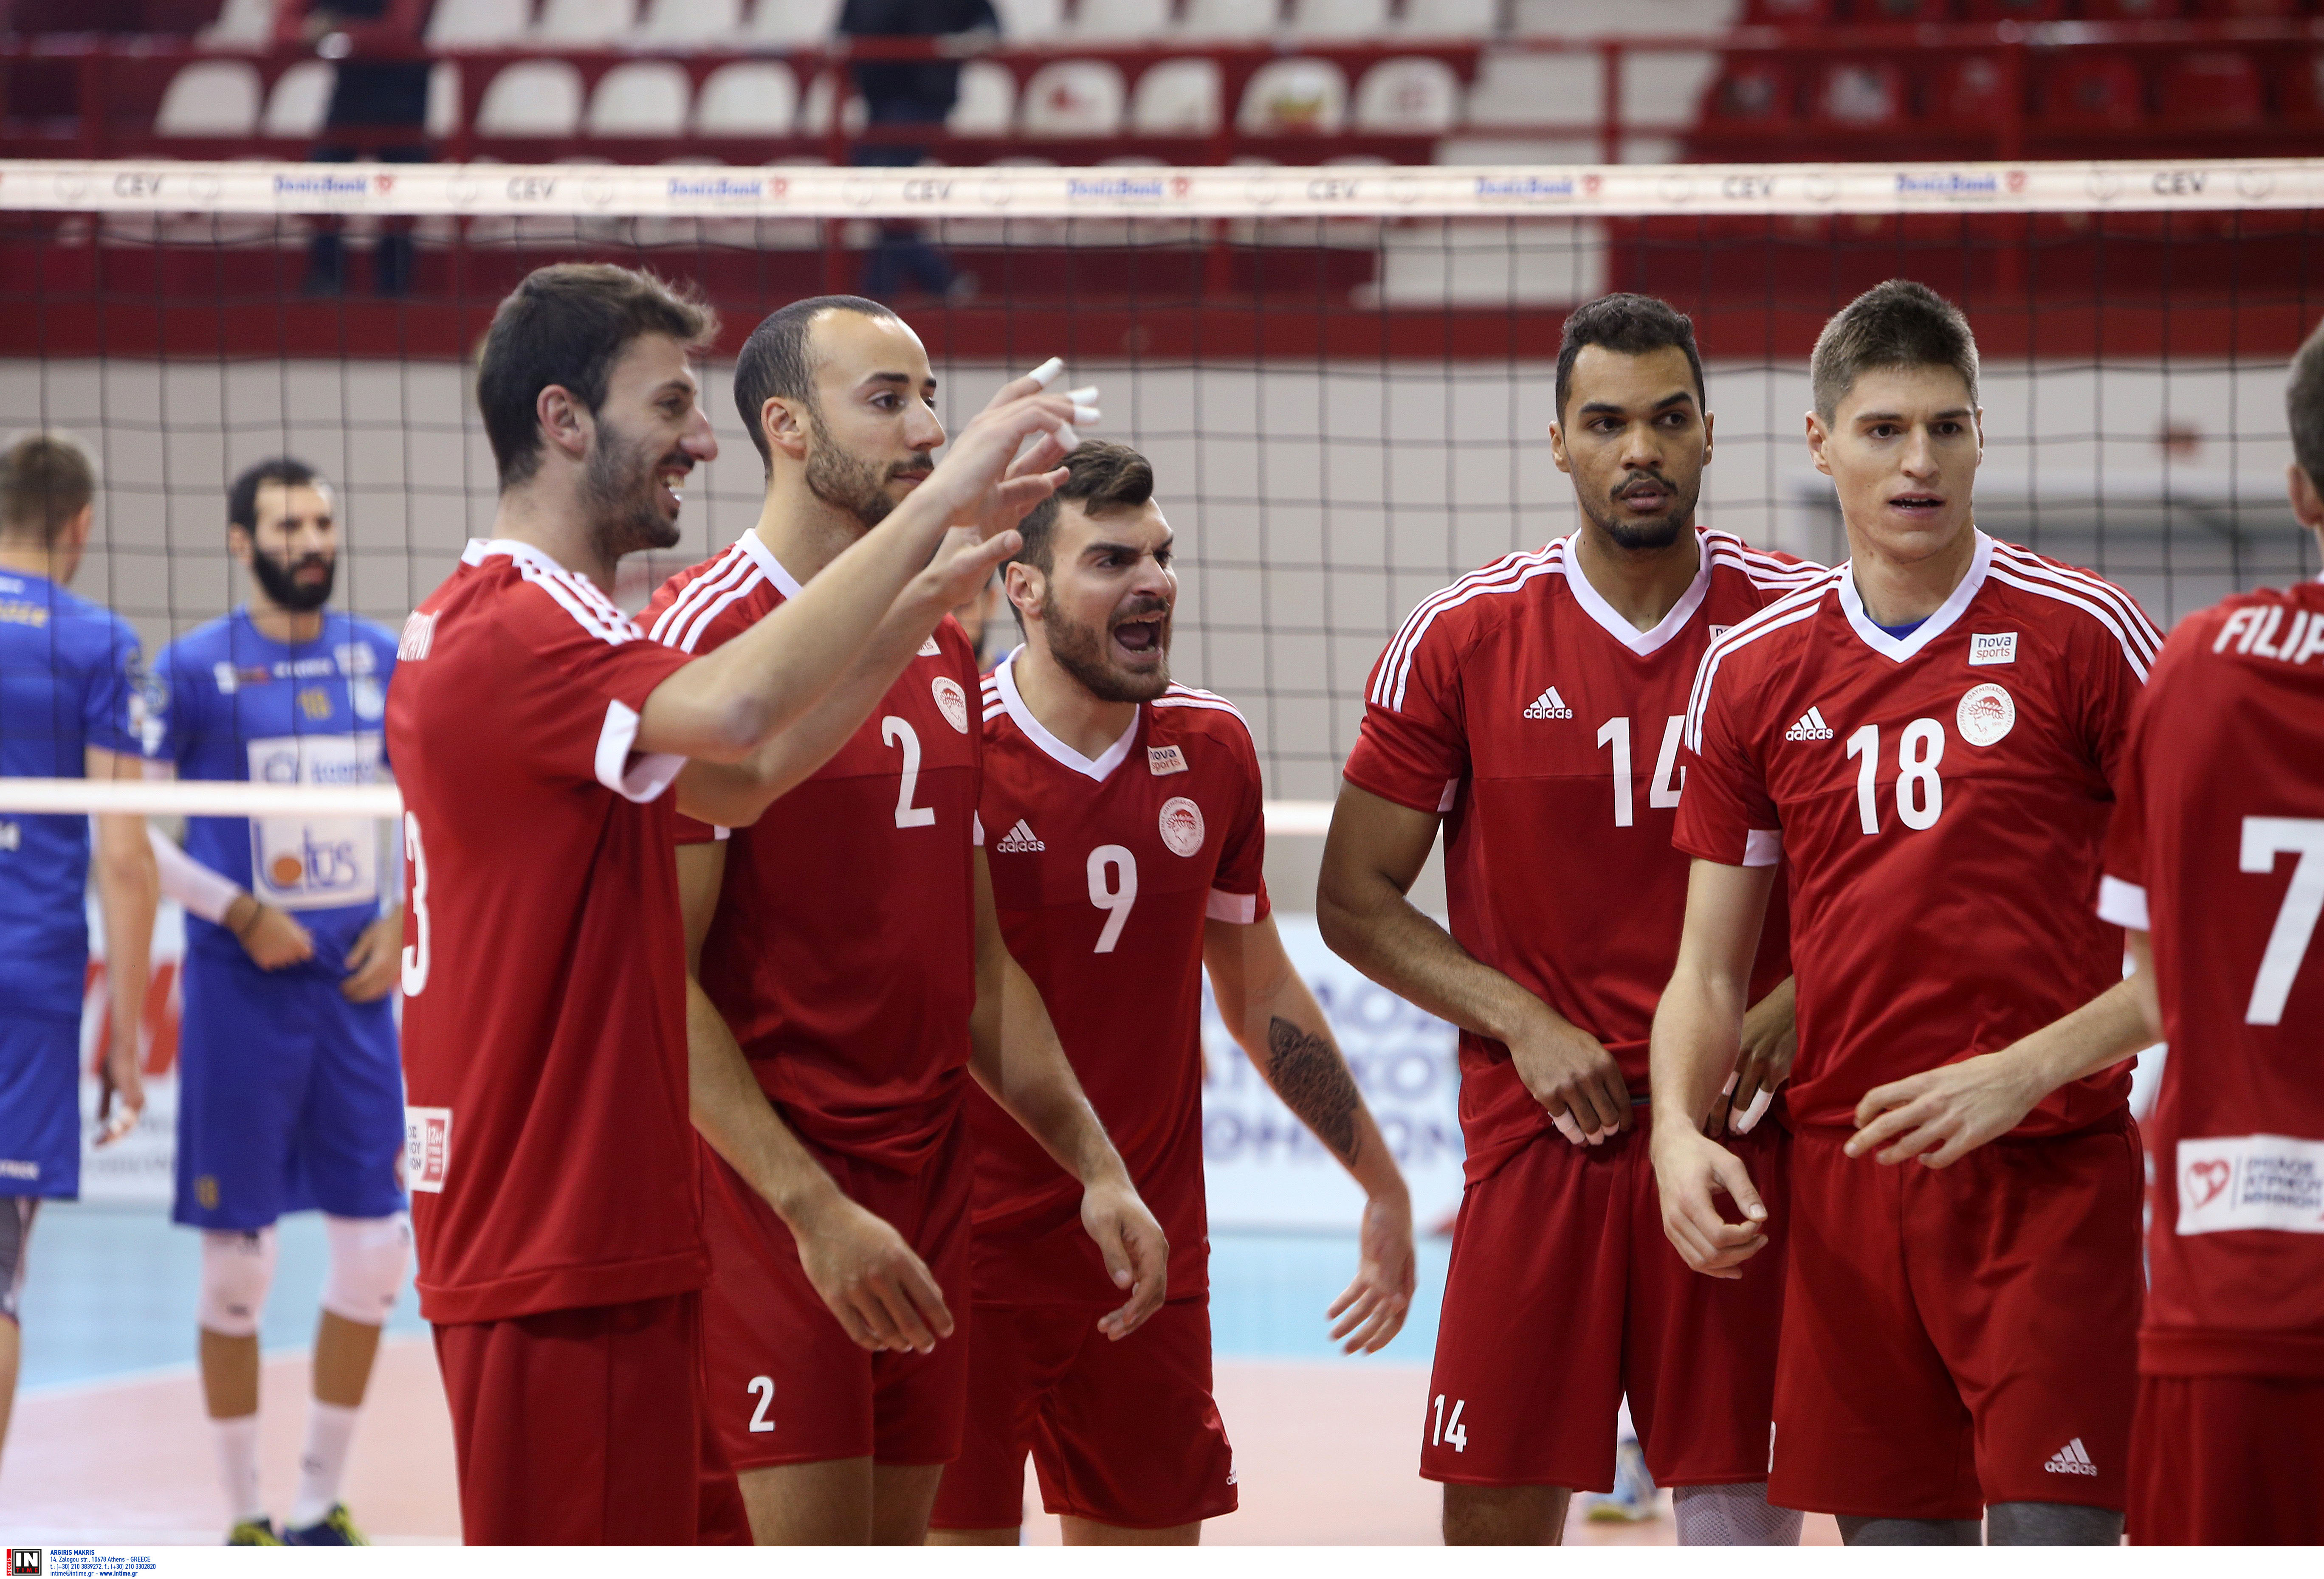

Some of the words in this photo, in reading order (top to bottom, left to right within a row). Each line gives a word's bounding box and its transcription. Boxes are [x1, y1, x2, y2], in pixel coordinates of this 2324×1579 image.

[113, 175, 165, 197] CEV
[506, 176, 558, 199] CEV
[902, 178, 952, 203] CEV
[1306, 177, 1361, 202] CEV
[1721, 175, 1777, 200] CEV
[2151, 171, 2207, 197] CEV
[1976, 647, 2010, 660] sports
[1978, 635, 2011, 649] nova
[1523, 707, 1573, 719] adidas
[1785, 727, 1833, 741] adidas
[881, 715, 935, 829] 2
[1151, 758, 1181, 772] sports
[1597, 715, 1687, 827] 14
[1846, 717, 1946, 835] 18
[997, 840, 1046, 853] adidas
[1086, 844, 1138, 954] 9
[2239, 816, 2324, 1025] 7
[747, 1375, 774, 1433] 2
[1433, 1394, 1467, 1453] 14
[2044, 1460, 2098, 1477] adidas
